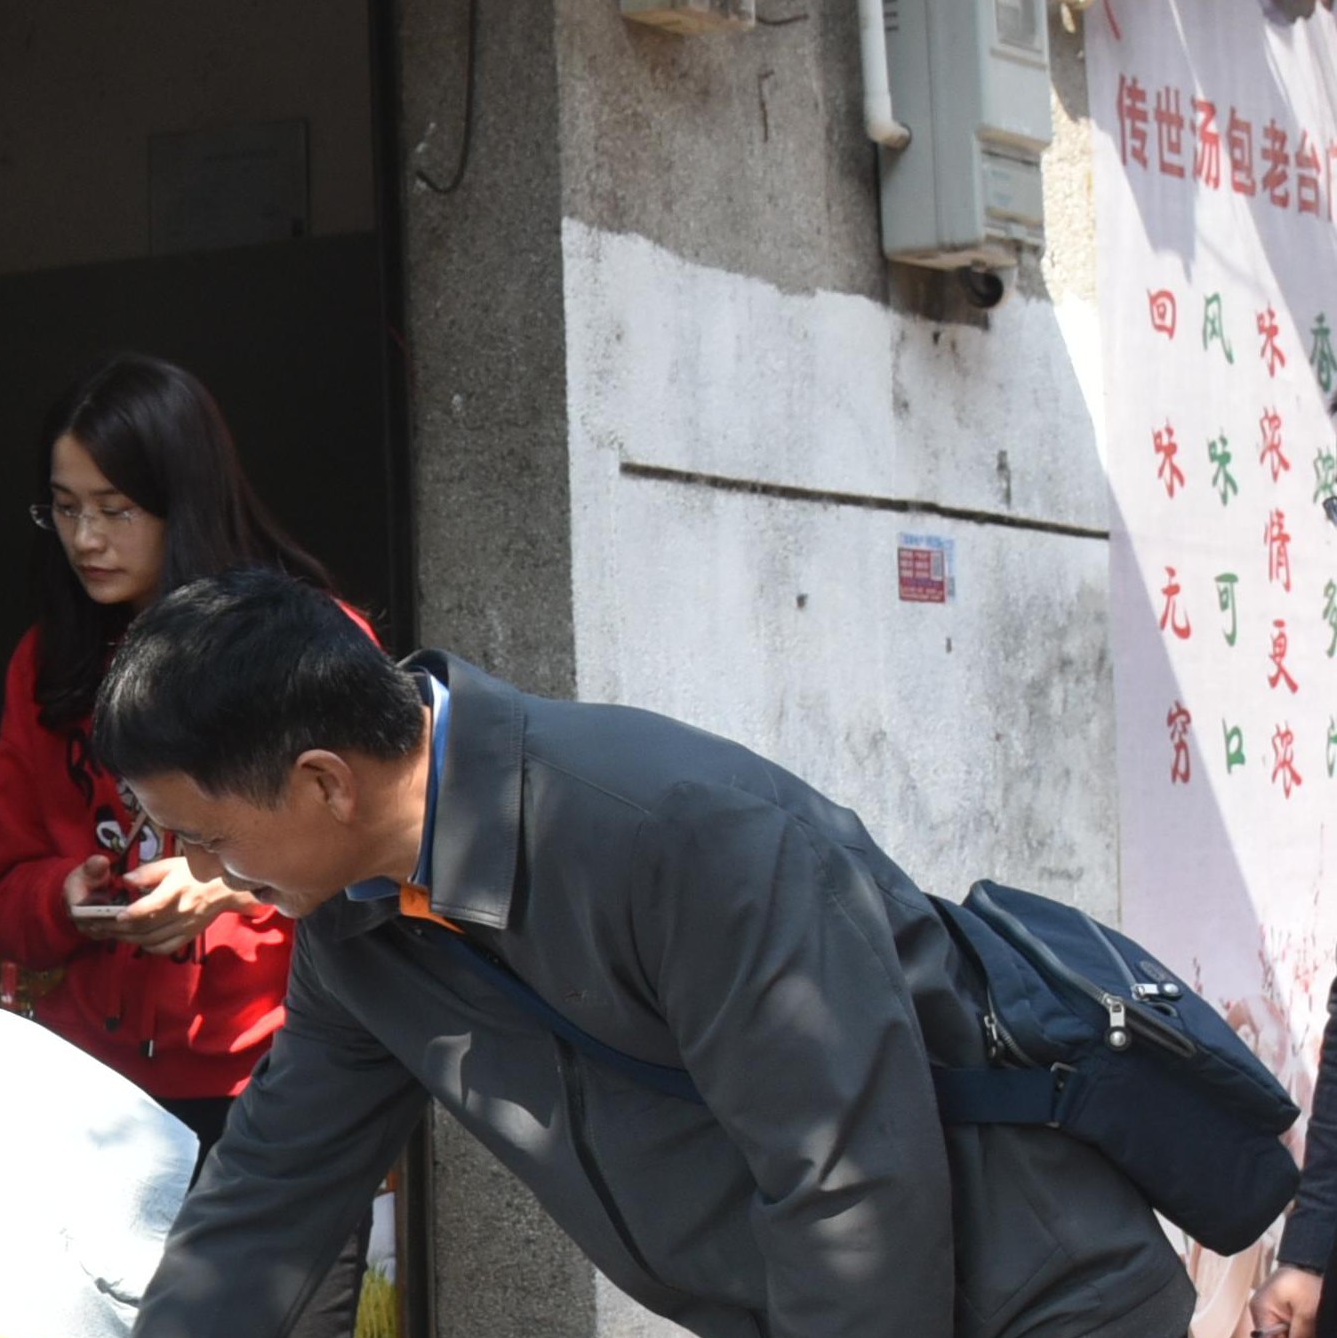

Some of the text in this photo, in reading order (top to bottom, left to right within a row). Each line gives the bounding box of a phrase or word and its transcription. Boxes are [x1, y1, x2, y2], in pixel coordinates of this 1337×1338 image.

[1117, 73, 1337, 223] 传世汤包老台
[1147, 288, 1192, 785] 回味无穷
[1202, 291, 1246, 775] 风味可口
[1256, 300, 1303, 800] 味浓情更浓
[1309, 311, 1337, 777] 香浓
